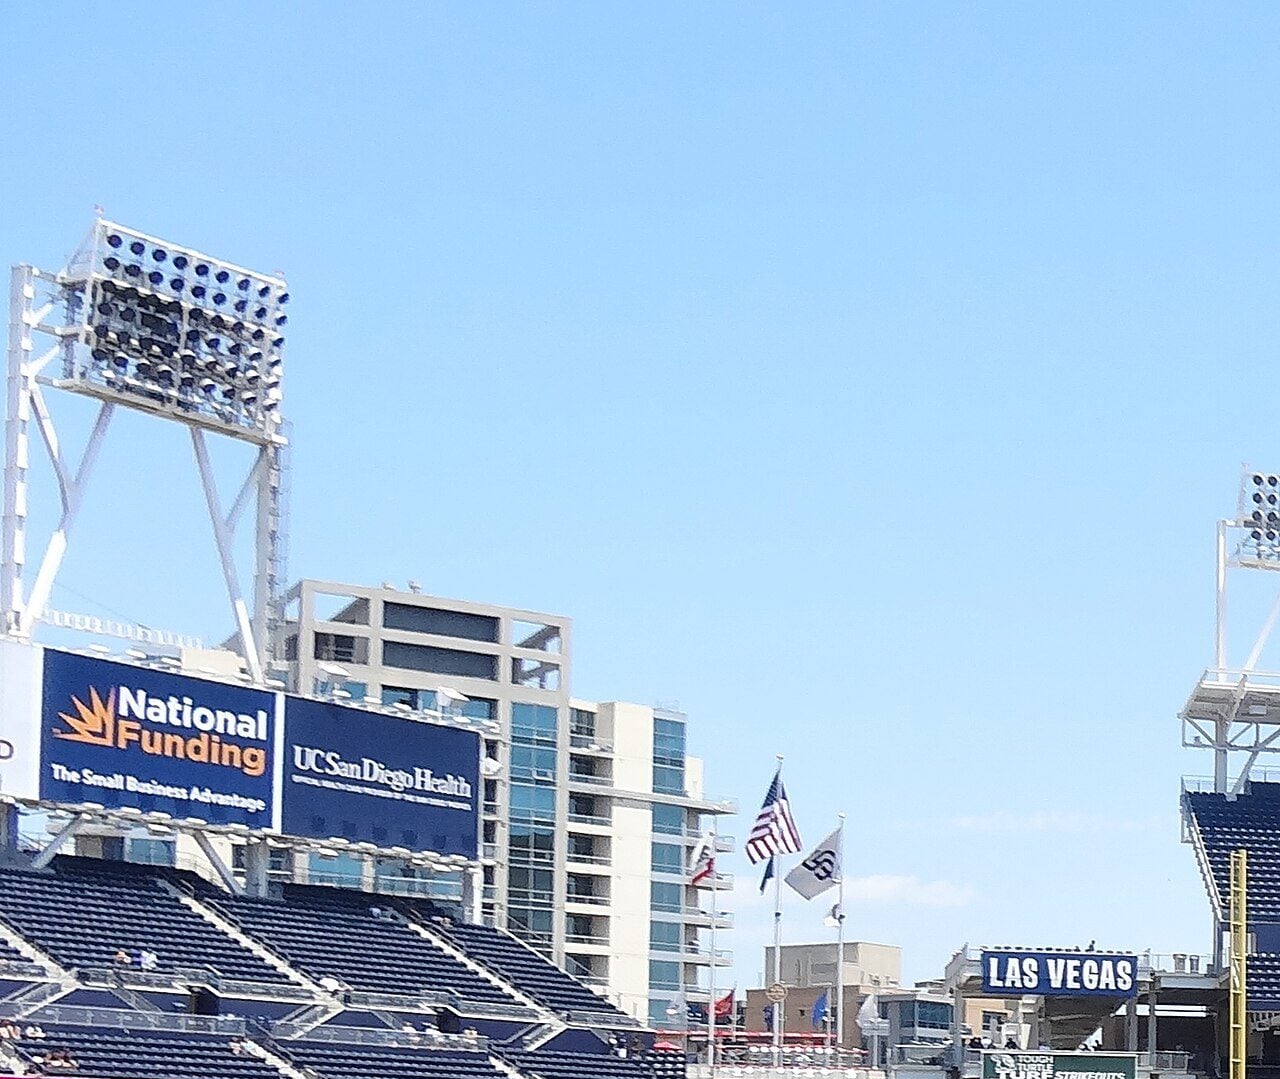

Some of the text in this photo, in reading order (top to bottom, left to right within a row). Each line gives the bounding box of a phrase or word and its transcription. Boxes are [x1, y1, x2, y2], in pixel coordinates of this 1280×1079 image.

[118, 686, 268, 740] National
[117, 719, 267, 776] Funding
[51, 763, 81, 783] The
[81, 769, 124, 790] Small
[126, 775, 188, 800] Business
[190, 787, 266, 812] Advantage
[292, 744, 325, 773] UC
[325, 751, 362, 780] San
[361, 758, 414, 791] Diego
[414, 767, 472, 797] Health
[989, 957, 1132, 990] LAS VEGAS
[996, 1070, 1053, 1079] TURF
[1017, 1055, 1053, 1063] TOUGH
[1017, 1063, 1053, 1071] TURTLE
